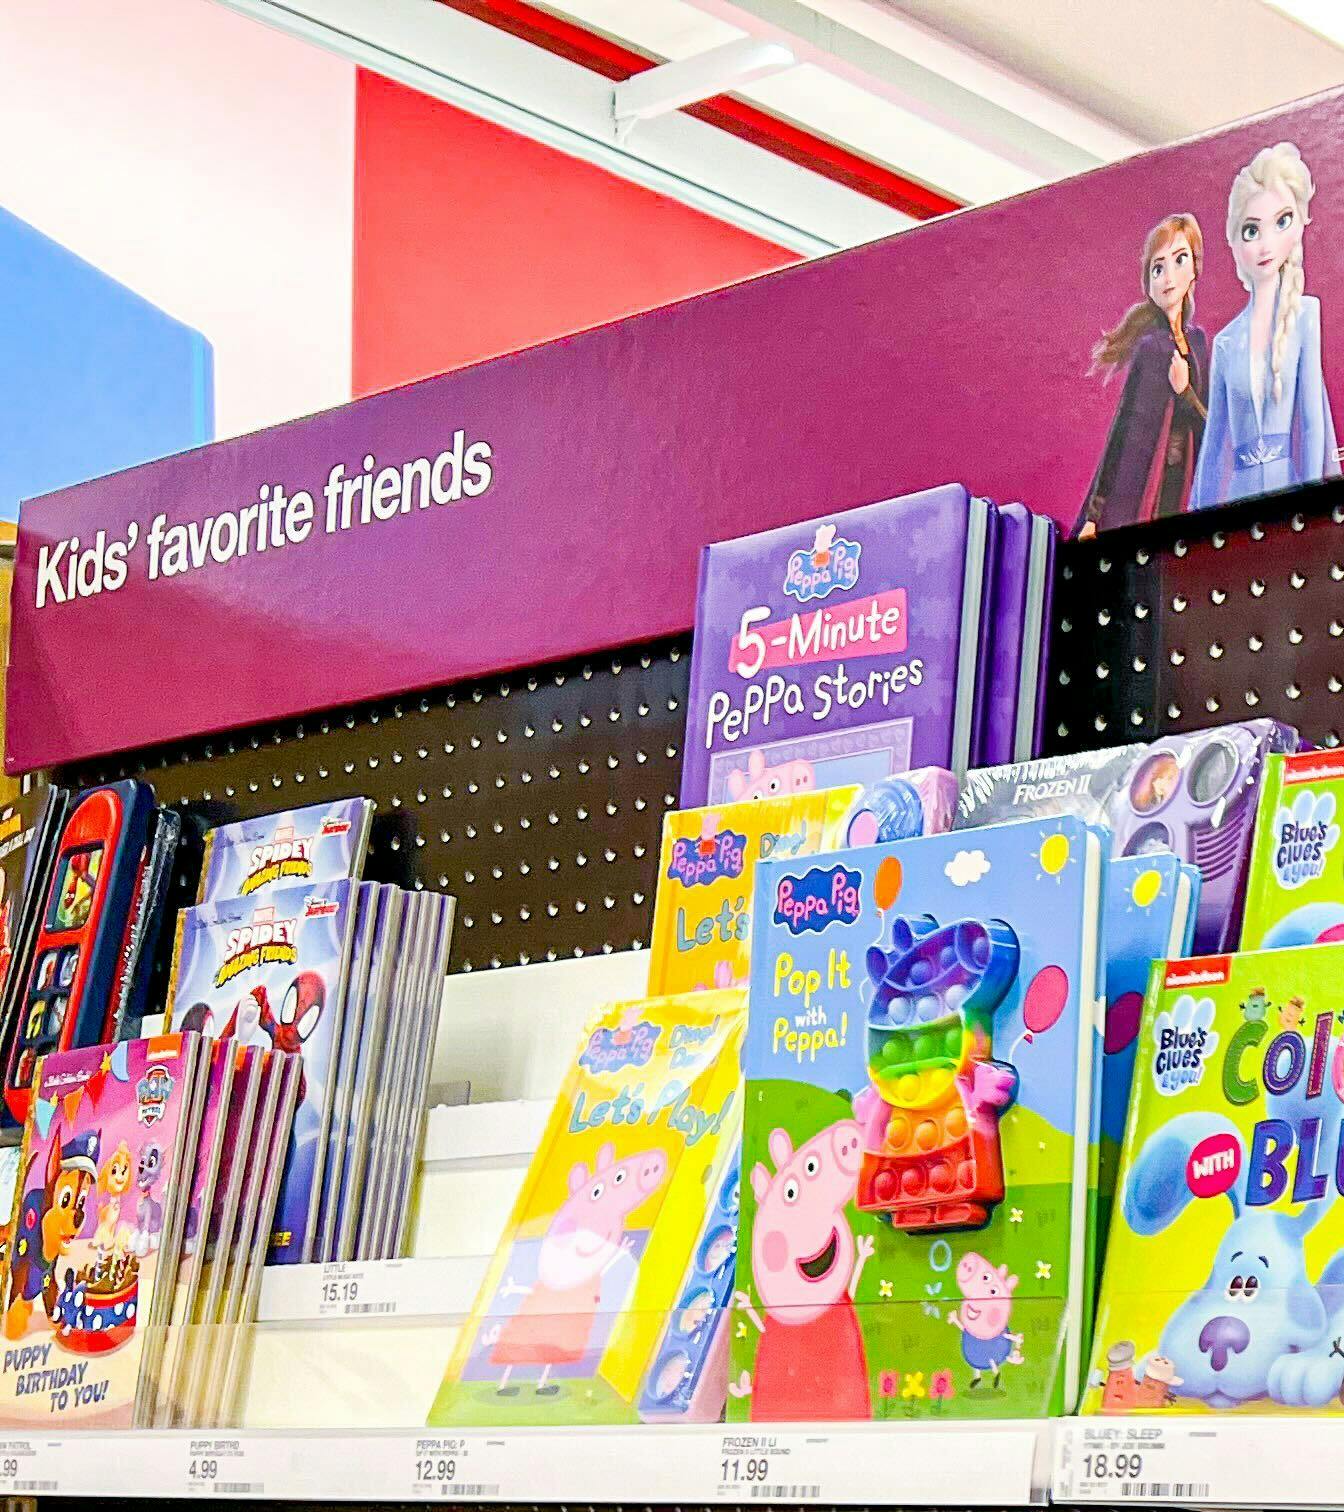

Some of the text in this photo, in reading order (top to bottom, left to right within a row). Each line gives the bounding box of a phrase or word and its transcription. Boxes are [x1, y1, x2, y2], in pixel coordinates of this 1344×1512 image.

[34, 429, 494, 609] Kids' favorite friends
[735, 605, 901, 678] 5-Minute
[705, 656, 923, 749] Peppa Stories
[773, 947, 851, 999] Pop It
[794, 1006, 828, 1027] with
[773, 1018, 848, 1064] Peppa!
[1192, 1150, 1235, 1181] WITH
[2, 1342, 53, 1374] PUPPY
[15, 1362, 89, 1398] BIRTHDAY
[188, 1460, 218, 1479] 4.99
[414, 1460, 456, 1481] 12.99
[721, 1459, 769, 1481] 11.99
[1083, 1454, 1143, 1479] 18.99
